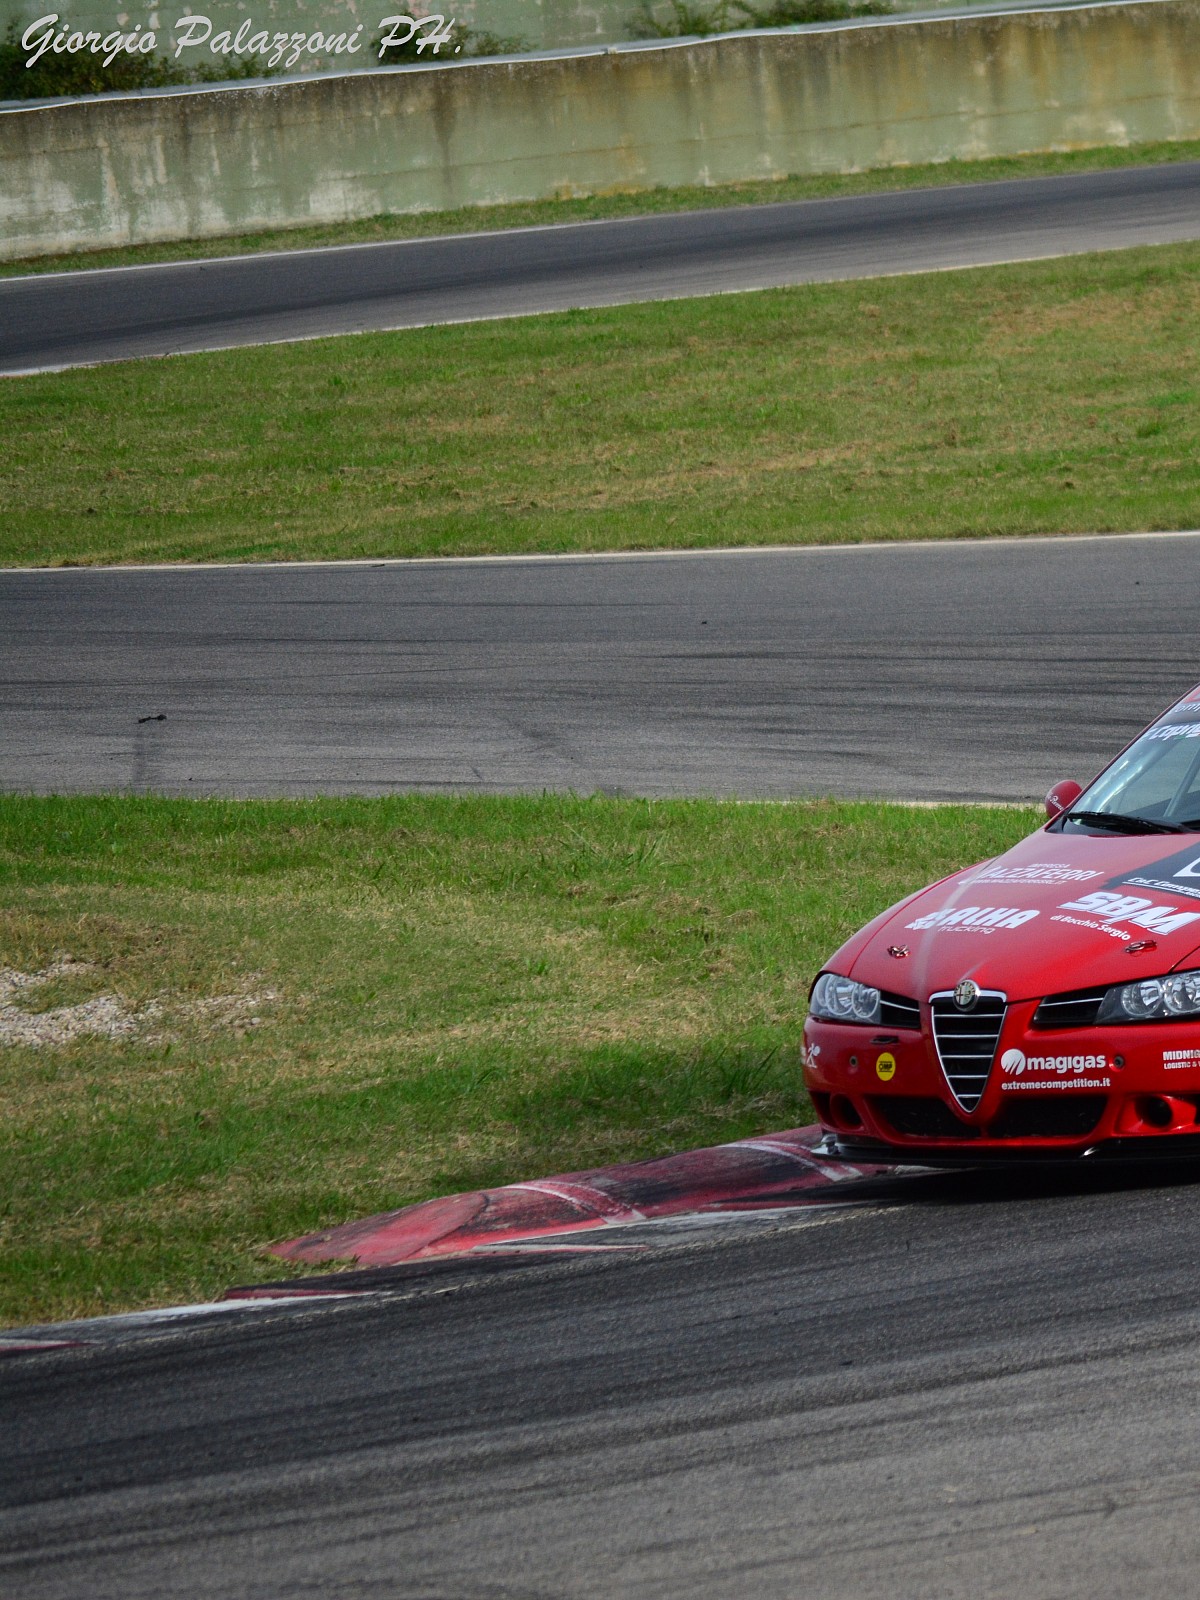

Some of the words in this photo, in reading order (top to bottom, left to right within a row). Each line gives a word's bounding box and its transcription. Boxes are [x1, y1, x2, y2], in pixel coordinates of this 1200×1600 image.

[1062, 916, 1098, 929] Bocchio
[1098, 923, 1131, 941] Sergio
[1027, 1055, 1106, 1074] magigas
[1001, 1078, 1110, 1090] extremecompetition.it
